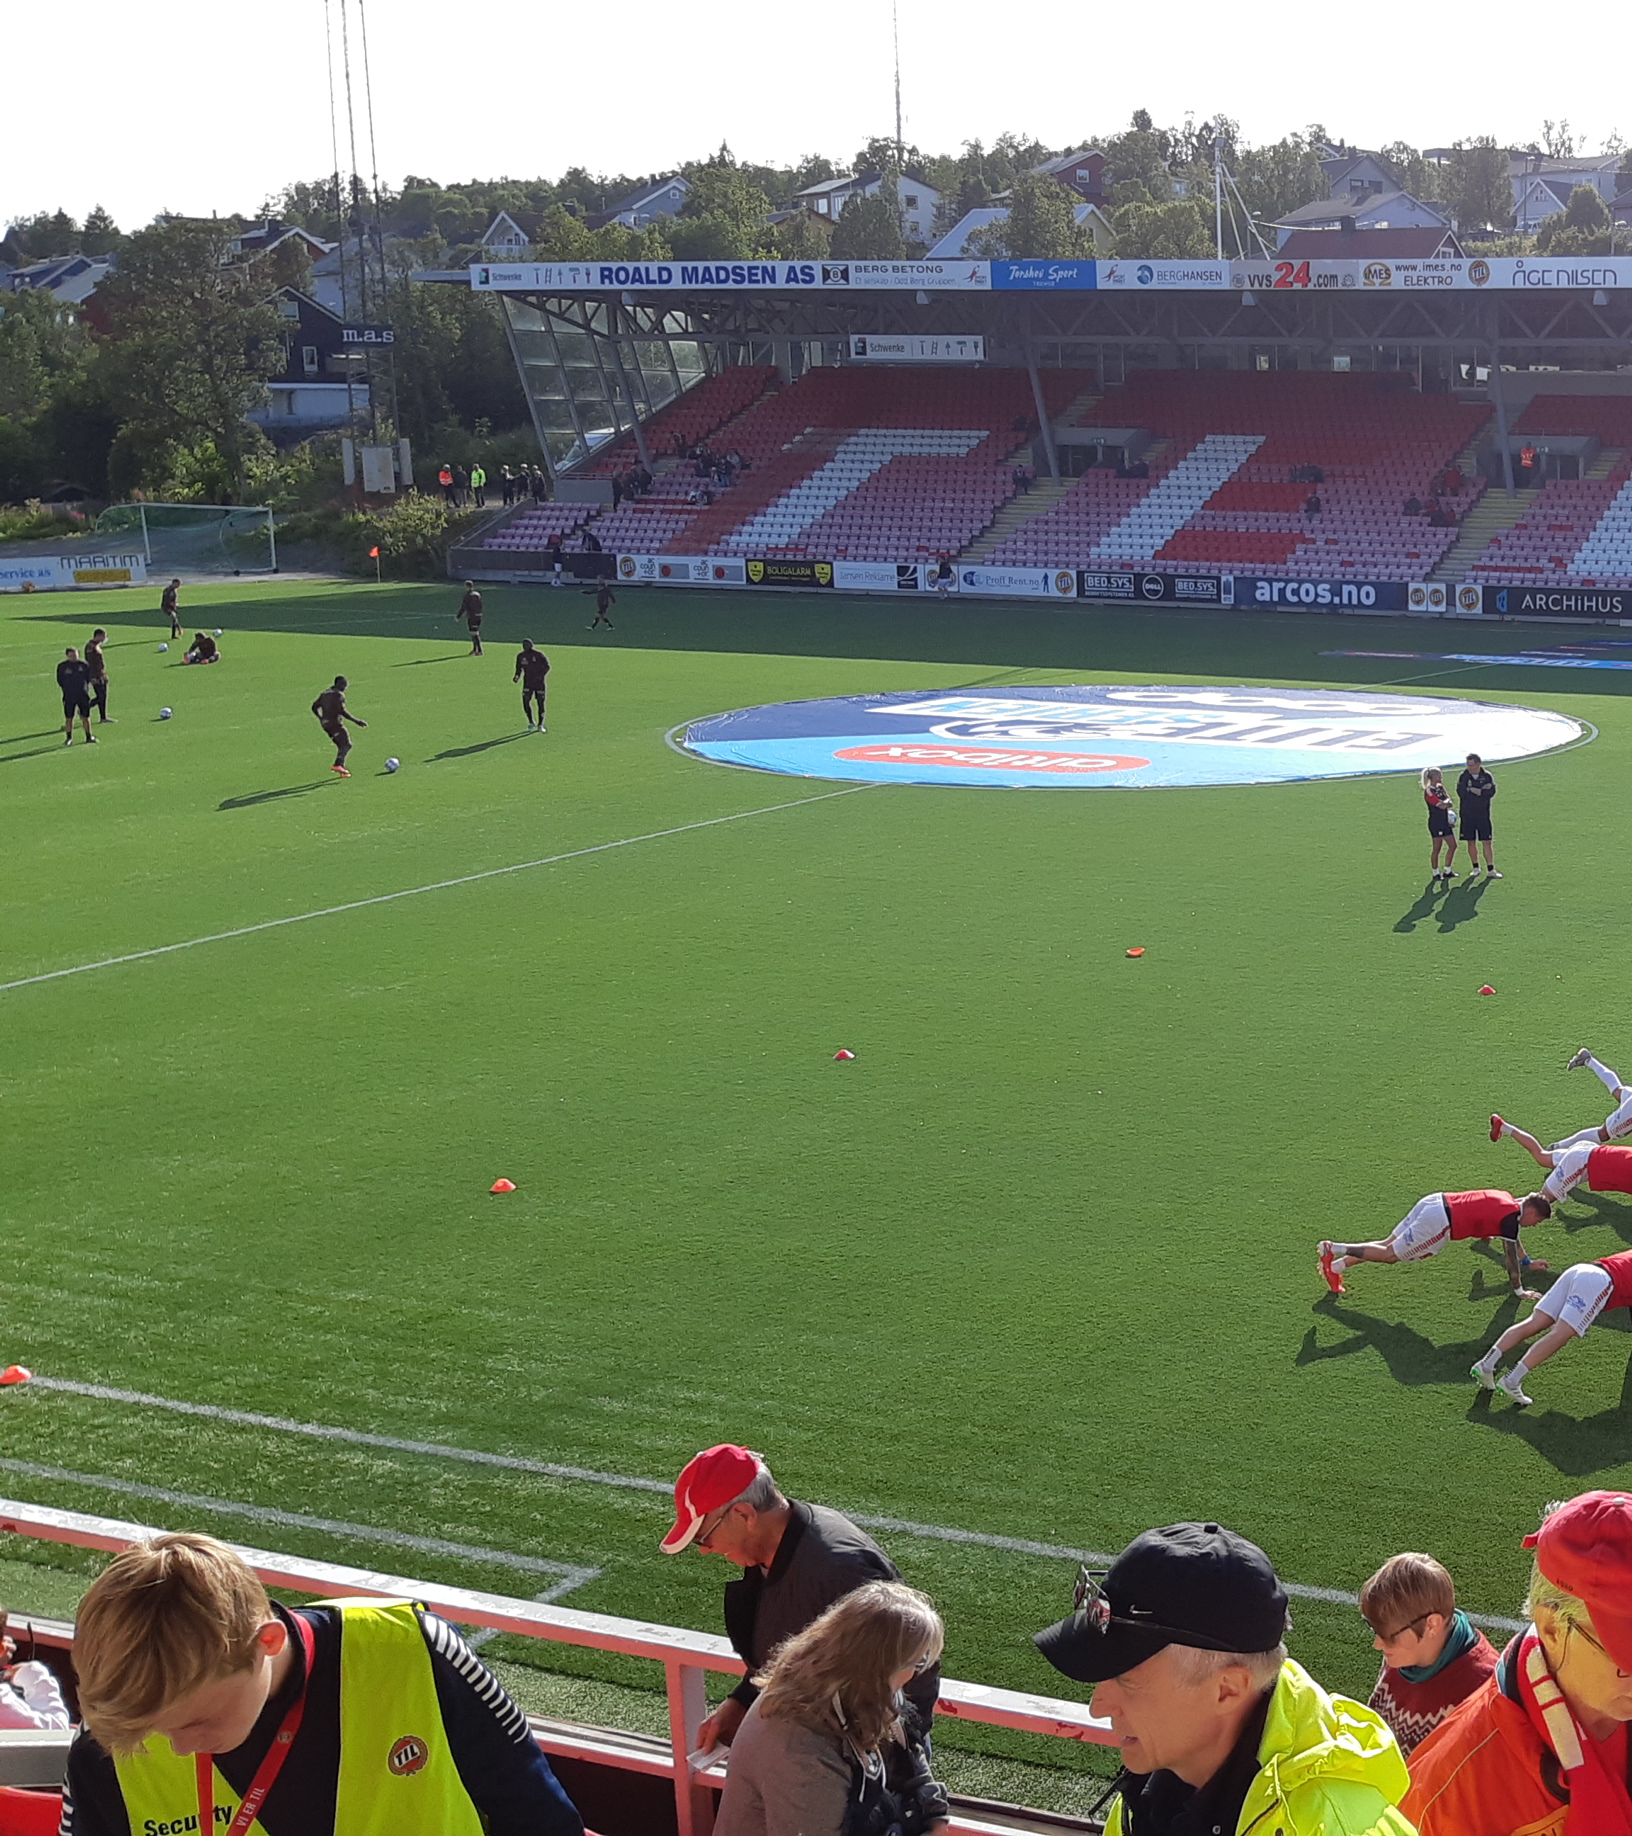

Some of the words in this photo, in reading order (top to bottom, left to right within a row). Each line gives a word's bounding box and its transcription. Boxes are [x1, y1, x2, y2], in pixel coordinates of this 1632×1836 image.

[854, 265, 889, 274] BERG
[892, 265, 944, 274] BETONG
[1394, 262, 1462, 273] www.imes.no
[1472, 267, 1486, 279] TIL
[1512, 260, 1552, 286] ÅGE
[1556, 269, 1617, 286] NILSEN
[600, 265, 673, 285] ROALD
[681, 265, 777, 285] MADSEN
[784, 265, 816, 285] AS
[1048, 265, 1078, 283] Sport
[1156, 270, 1223, 281] BERGHANSEN
[1404, 275, 1453, 287] ELEKTRO
[342, 329, 395, 343] m.a.s
[869, 343, 905, 353] Schwenke
[766, 566, 812, 576] BOLIGALARM
[985, 575, 1006, 585] Proff
[1059, 577, 1070, 587] TIL
[1255, 581, 1376, 606] arcos.no
[1463, 592, 1476, 603] TIL
[866, 746, 1117, 770] altibox
[394, 1744, 419, 1767] TIL
[236, 1816, 249, 1827] VI
[243, 1802, 256, 1815] ER
[250, 1788, 265, 1801] TIL
[143, 1804, 233, 1836] Secuty
